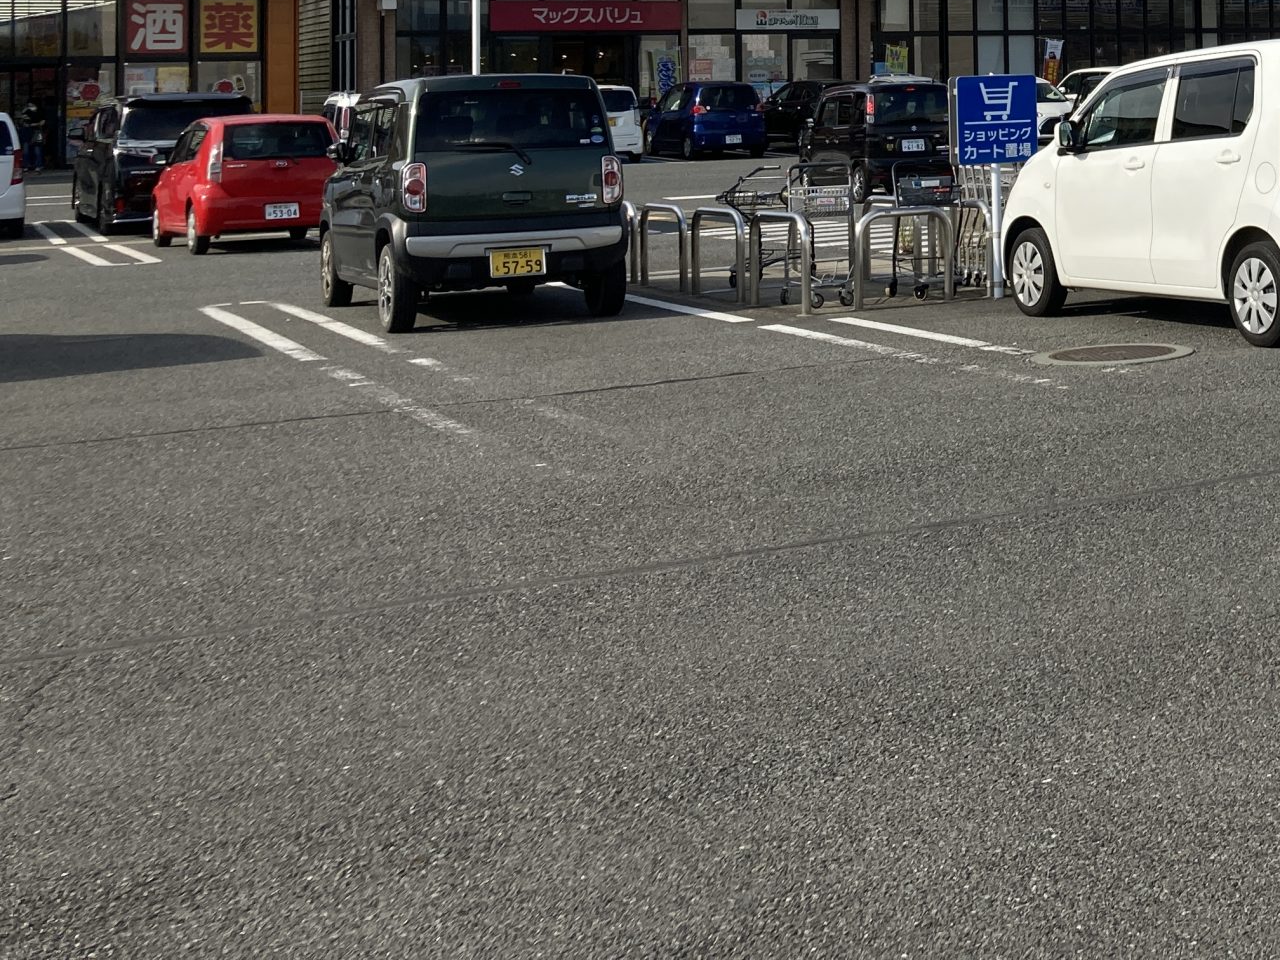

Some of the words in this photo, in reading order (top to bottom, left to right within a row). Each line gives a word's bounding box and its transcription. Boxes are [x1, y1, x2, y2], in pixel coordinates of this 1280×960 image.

[532, 7, 643, 23] マックスバリュ
[131, 2, 183, 50] 酒
[203, 2, 254, 50] 薬
[964, 126, 1031, 142] ショッピング
[964, 142, 1031, 160] カート置場
[502, 259, 543, 275] 57-59
